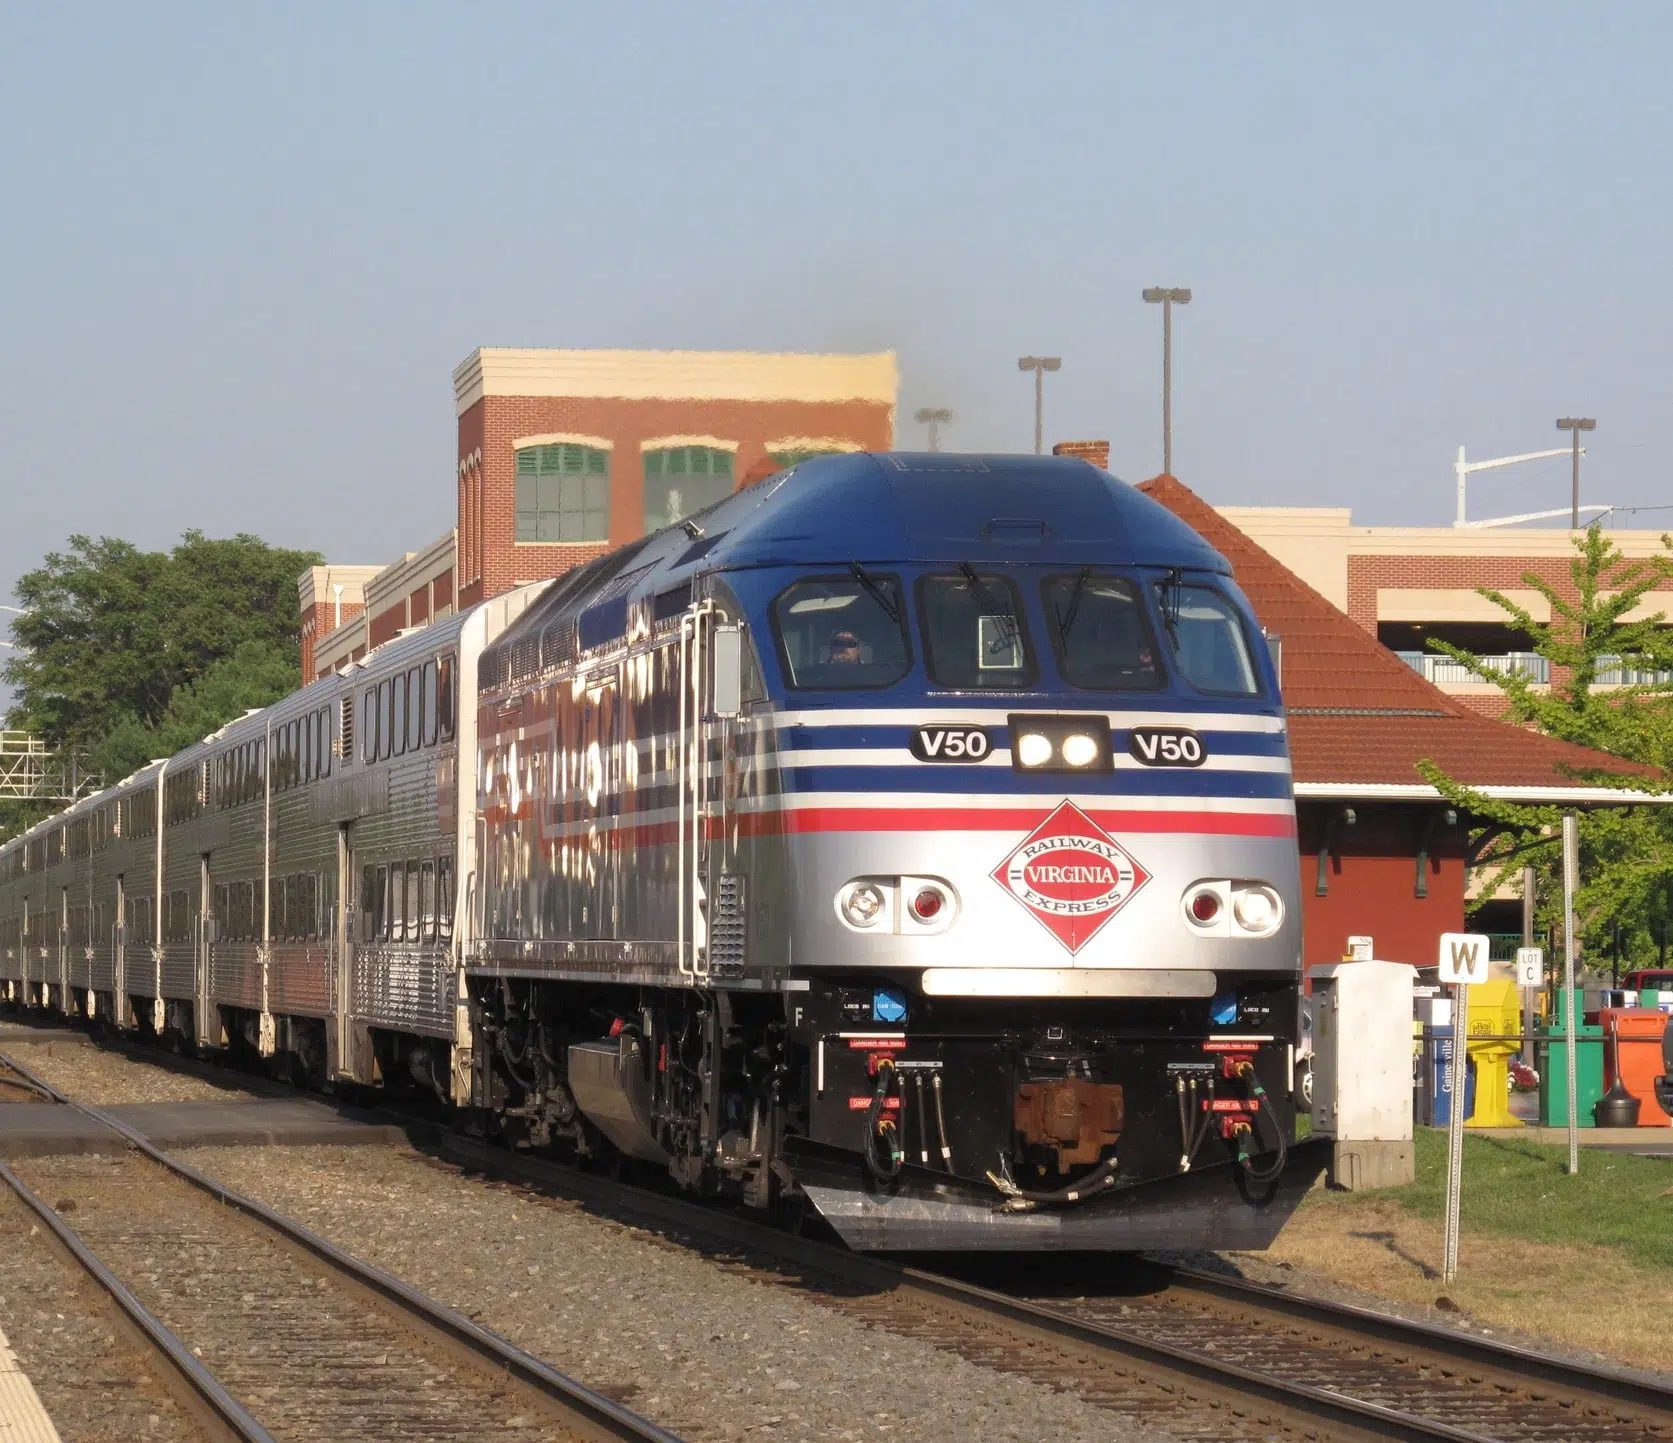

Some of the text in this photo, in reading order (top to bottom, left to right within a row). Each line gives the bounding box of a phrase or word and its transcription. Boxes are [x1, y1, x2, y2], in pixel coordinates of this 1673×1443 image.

[920, 731, 987, 757] V50
[1135, 734, 1201, 761] V50
[1023, 838, 1120, 860] RAILWAY
[1027, 865, 1116, 884] VIRGINIA
[1024, 889, 1121, 913] EXPRESS
[1451, 941, 1479, 976] W
[1522, 952, 1538, 964] LOT
[1526, 967, 1534, 981] C
[795, 1007, 803, 1027] F
